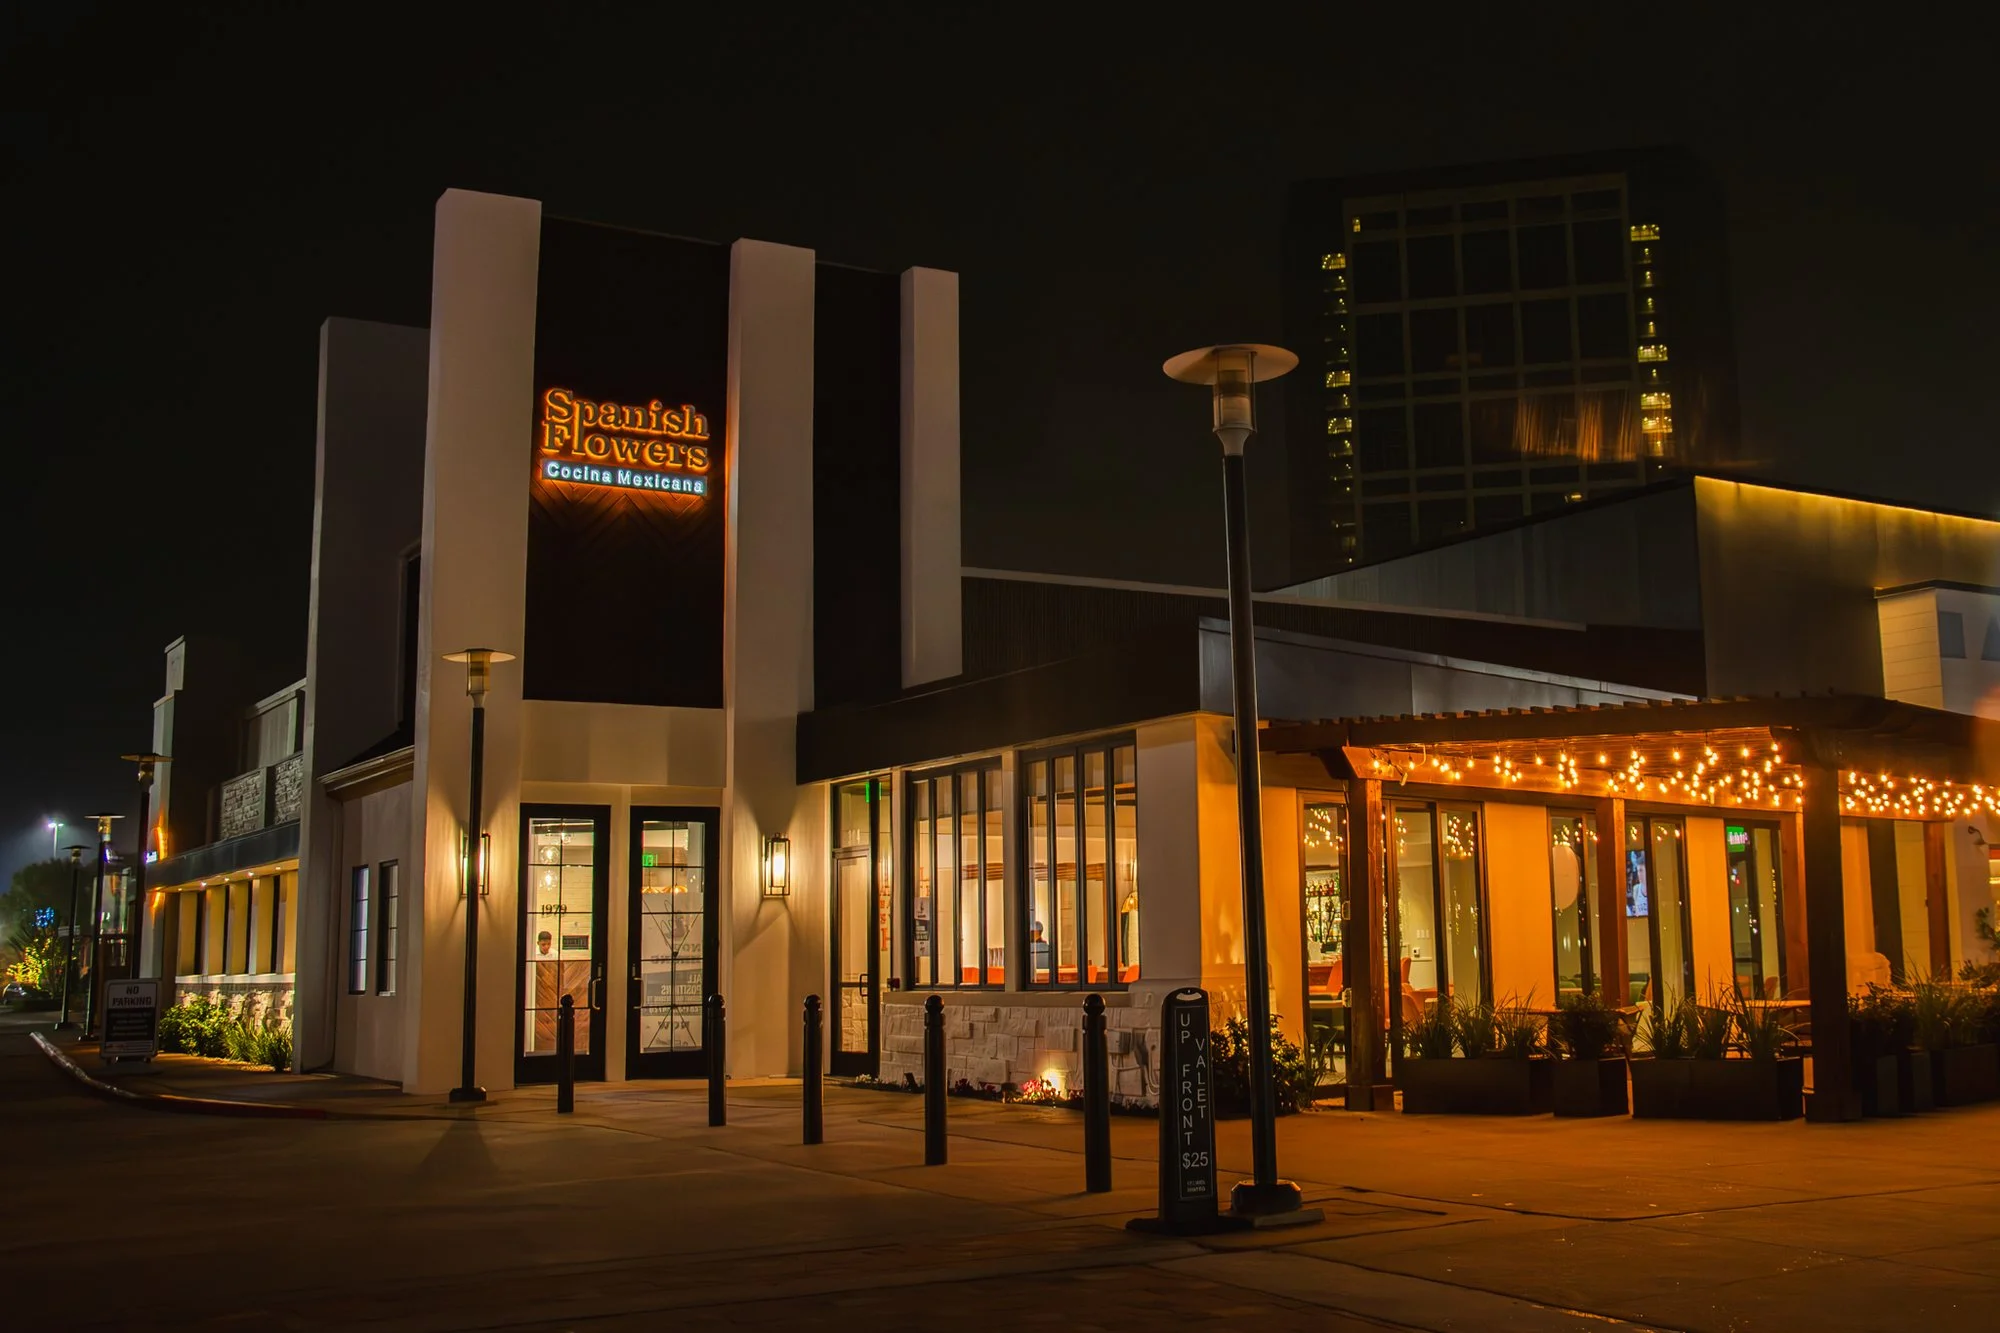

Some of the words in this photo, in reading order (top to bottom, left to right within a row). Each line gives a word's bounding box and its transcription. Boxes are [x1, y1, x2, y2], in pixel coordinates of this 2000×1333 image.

[545, 387, 710, 440] Spanish
[541, 418, 711, 471] Flowers
[547, 461, 612, 484] Cocina
[617, 469, 704, 494] Mexicana
[541, 903, 567, 917] 1979
[112, 996, 152, 1007] PARKING
[126, 985, 140, 995] NO
[1180, 1012, 1192, 1044] UP
[1195, 1037, 1208, 1120] VALET
[1181, 1063, 1193, 1147] FRONT
[1182, 1152, 1209, 1170] $25
